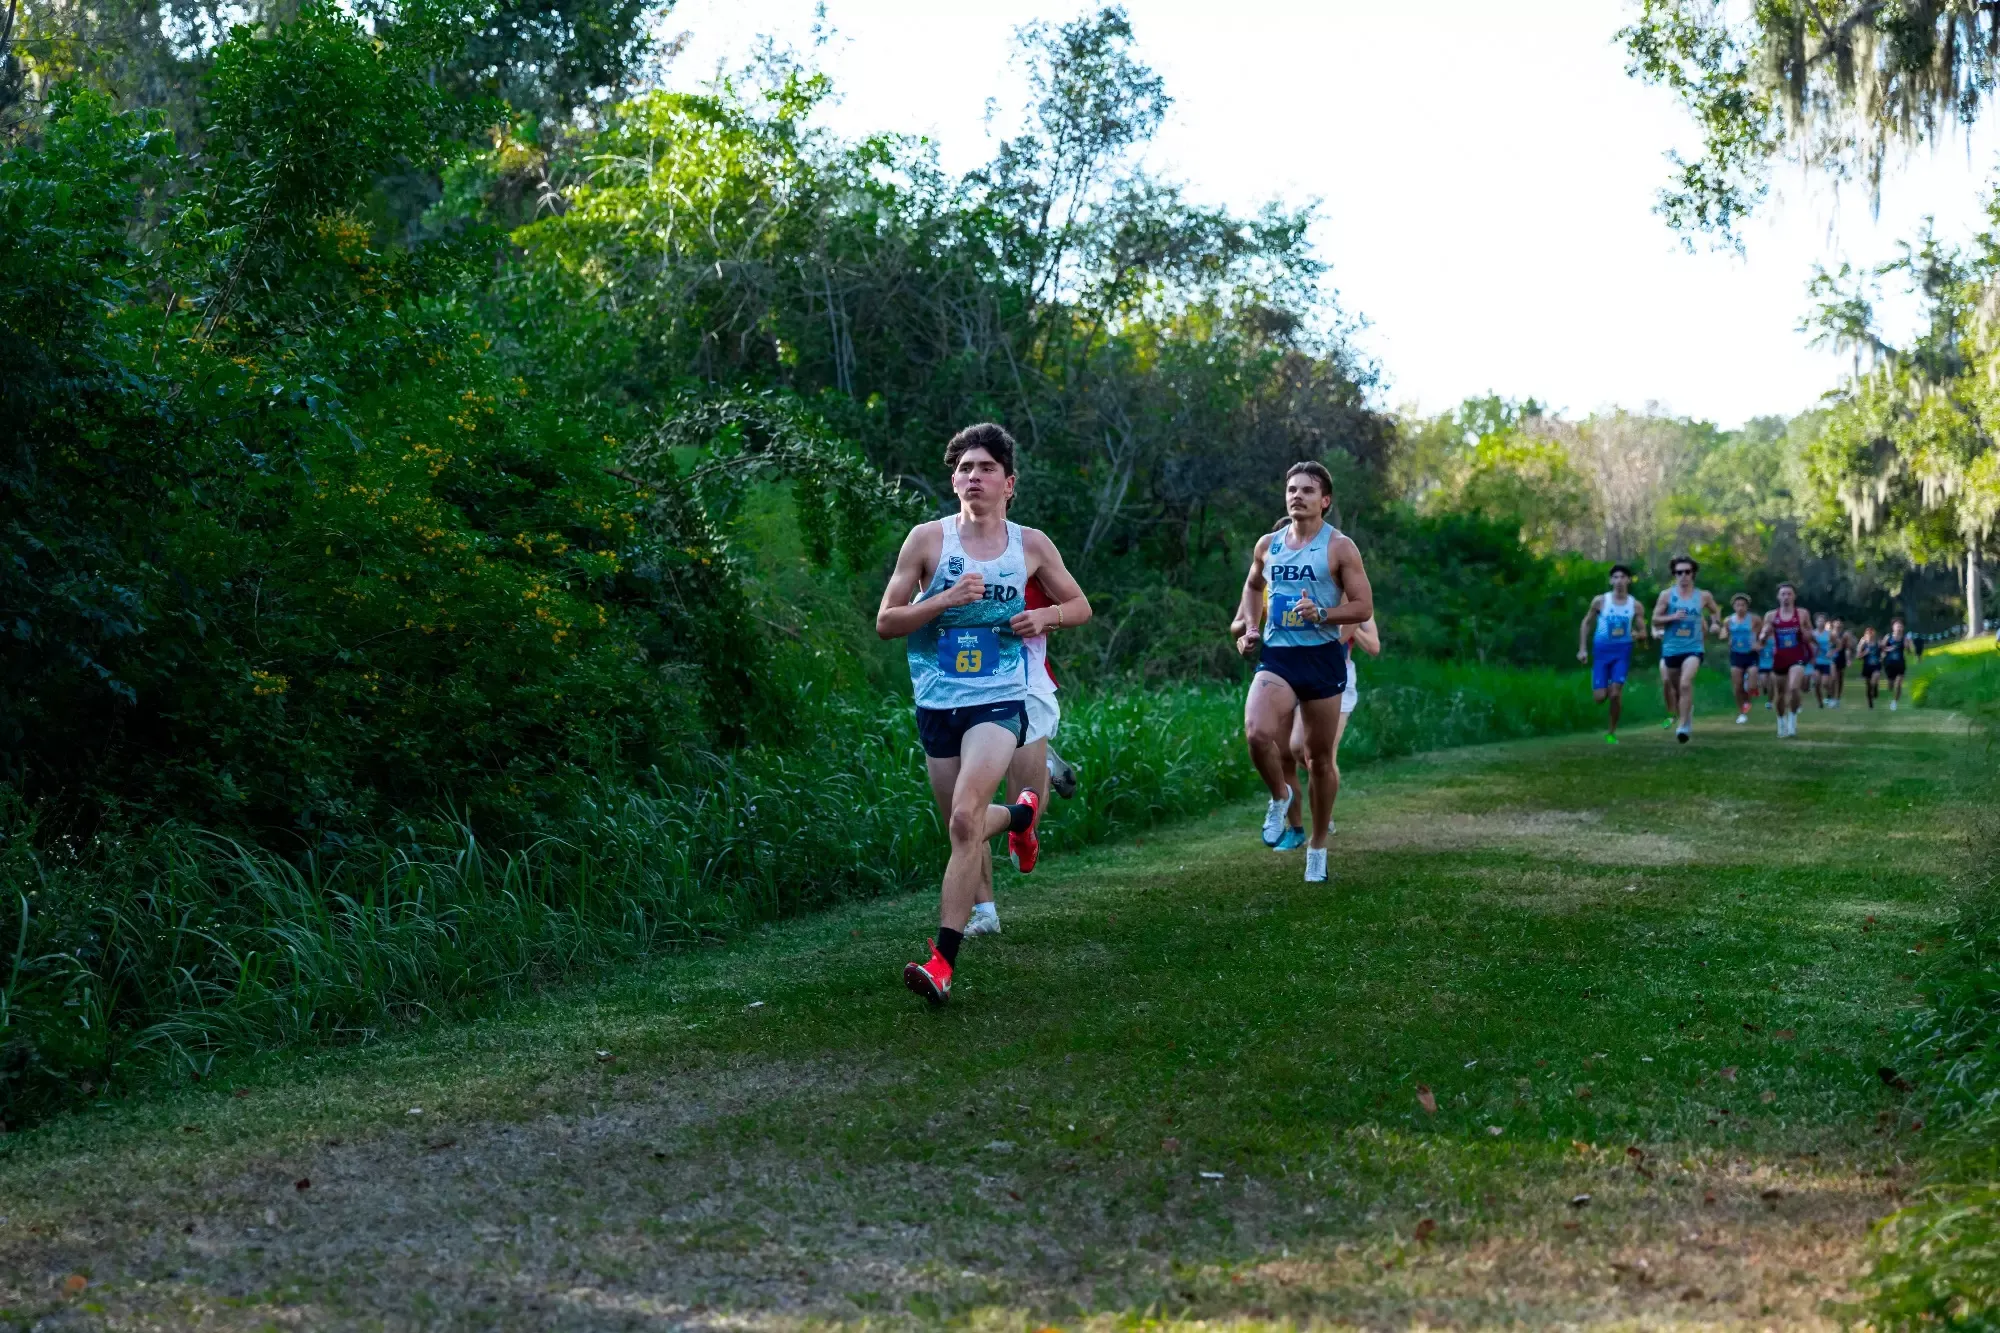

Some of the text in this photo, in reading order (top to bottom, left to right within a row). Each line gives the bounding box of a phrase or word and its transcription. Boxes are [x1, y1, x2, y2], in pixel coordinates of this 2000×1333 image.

[1271, 564, 1318, 581] PBA
[944, 580, 1018, 602] EERD
[956, 650, 982, 673] 63
